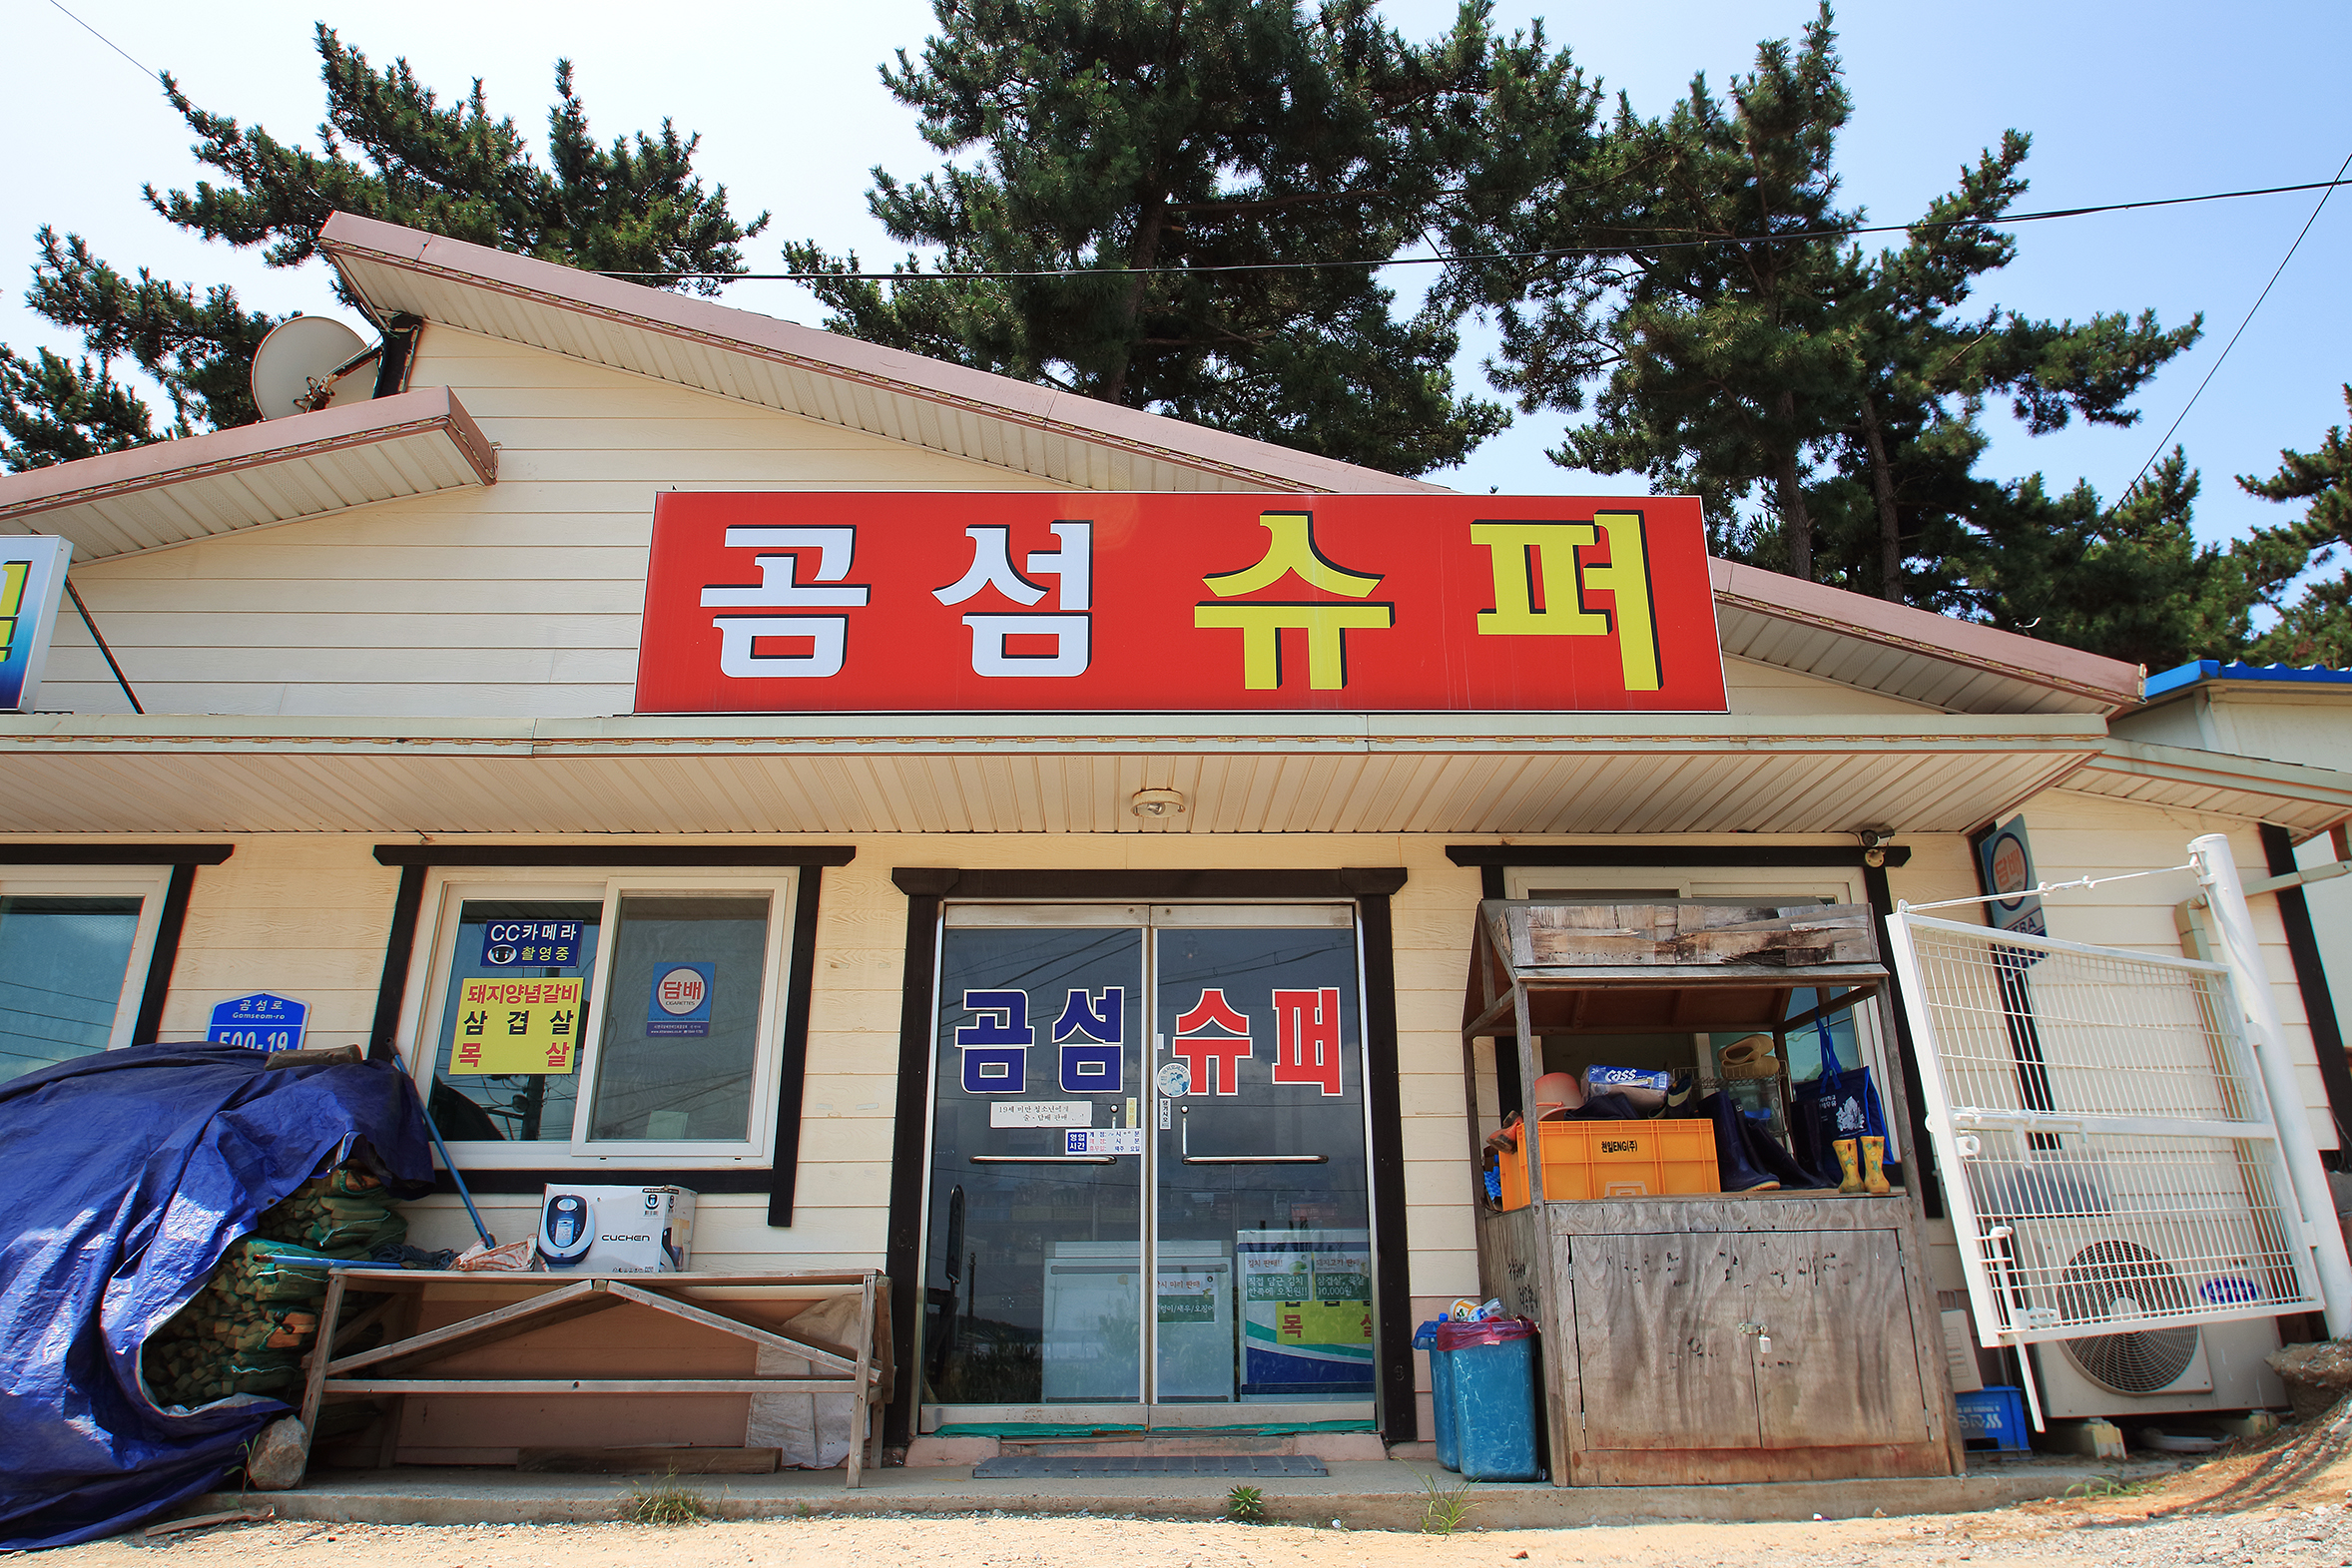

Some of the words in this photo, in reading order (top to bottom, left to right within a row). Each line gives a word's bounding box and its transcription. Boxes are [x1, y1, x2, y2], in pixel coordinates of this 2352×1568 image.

[699, 518, 1093, 679] 곰섬
[1193, 509, 1665, 693] 슈퍼
[1995, 848, 2024, 887] 담배
[490, 923, 577, 942] CC카메라
[521, 946, 570, 961] 촬영중
[467, 983, 579, 1004] 돼지양념갈비
[663, 981, 702, 999] 담배
[240, 999, 283, 1011] 곰섬로
[232, 1011, 286, 1020] Gomseom-ro
[219, 1031, 290, 1053] 500-19
[954, 986, 1125, 1094] 곰섬
[1172, 986, 1344, 1097] 슈퍼
[1069, 1133, 1085, 1142] 영업
[1069, 1142, 1085, 1151] 시간
[1601, 1140, 1637, 1153] 천일ENG(주)
[1248, 1276, 1264, 1288] 직접
[1267, 1276, 1284, 1288] 담근
[1288, 1276, 1303, 1288] 김치
